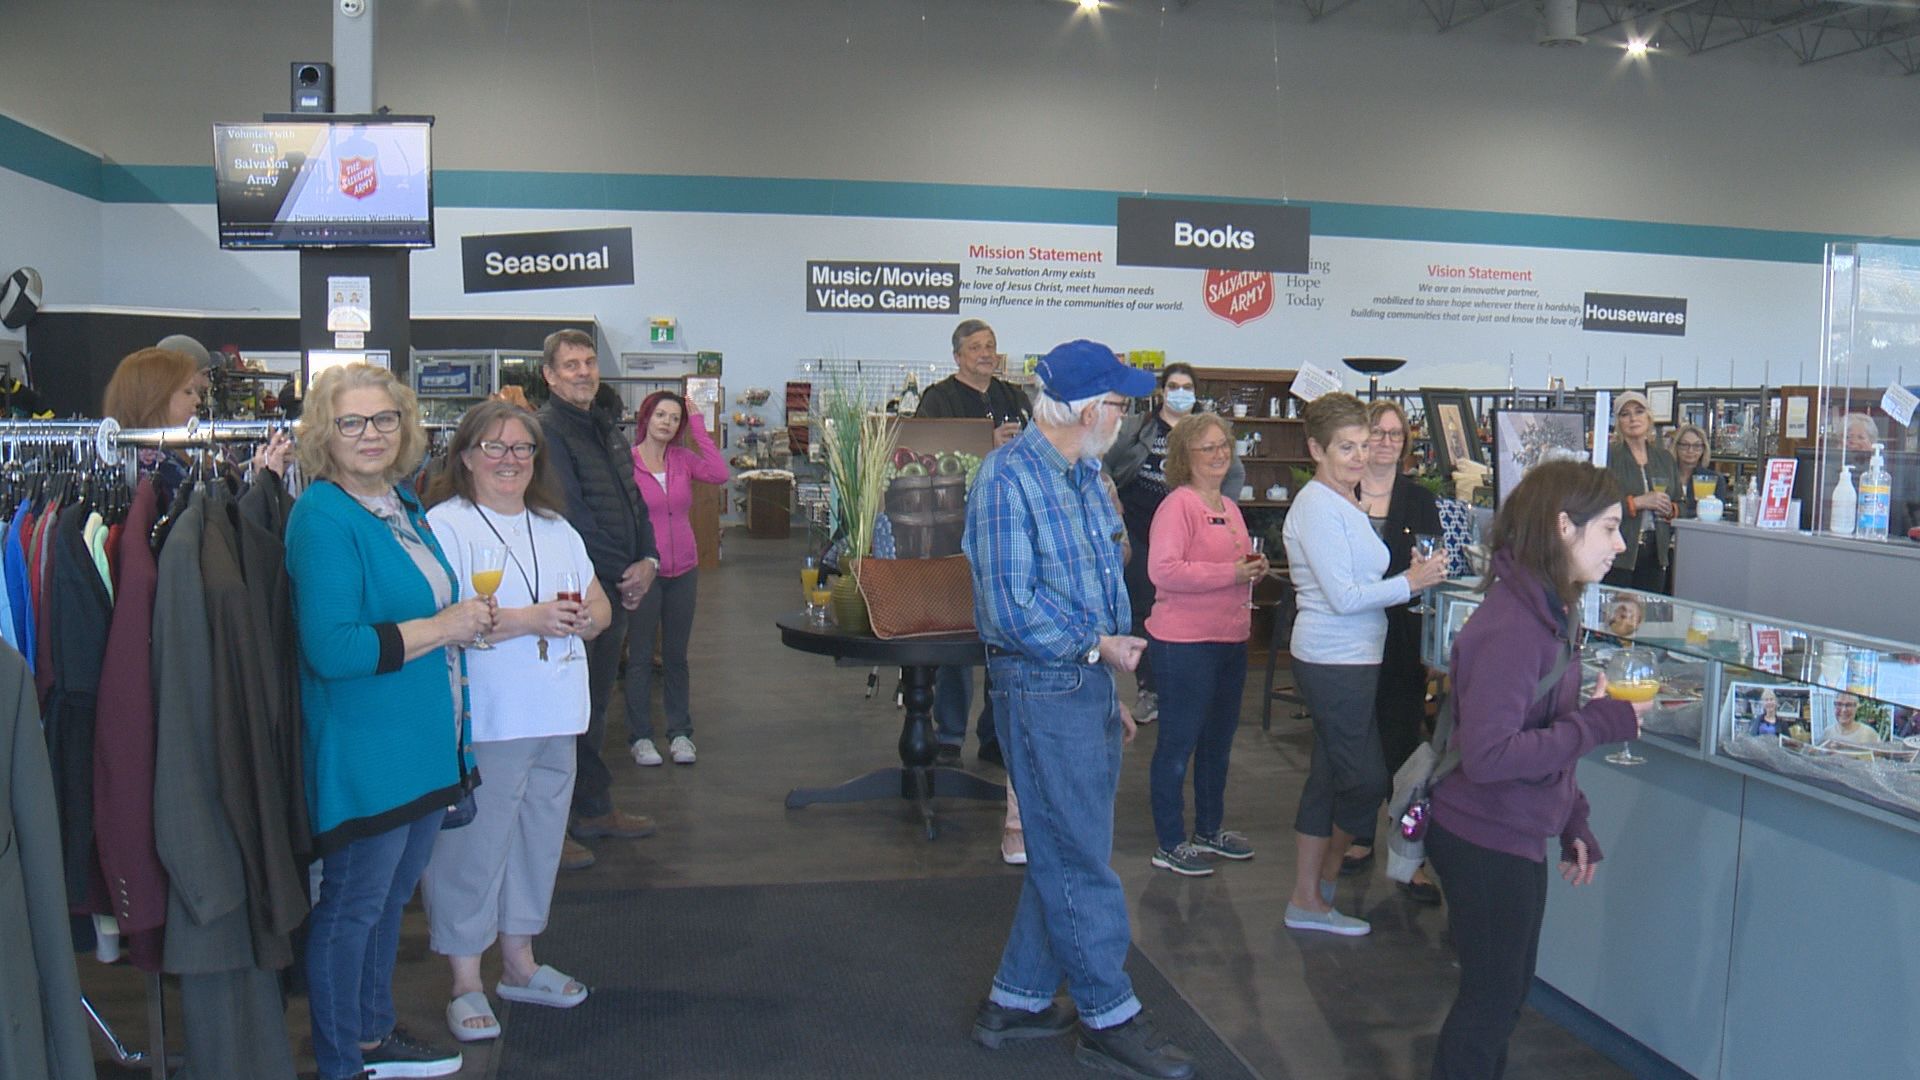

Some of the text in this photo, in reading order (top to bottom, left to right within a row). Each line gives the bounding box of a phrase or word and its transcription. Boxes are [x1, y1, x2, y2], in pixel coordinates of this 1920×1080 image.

[227, 129, 296, 139] Volunteer with
[251, 143, 275, 154] The
[234, 157, 289, 169] Salvation
[246, 174, 279, 187] Army
[353, 177, 375, 196] ARMY
[1174, 221, 1255, 250] Books
[485, 246, 610, 276] Seasonal
[969, 244, 1103, 263] Mission Statement
[812, 265, 954, 287] Music/Movies
[975, 265, 1096, 280] The Salvation Army exists
[1427, 264, 1533, 282] Vision Statement
[959, 280, 1155, 296] he love of Jesus Christ, meet human needs
[1286, 275, 1321, 293] Hope
[1418, 283, 1540, 298] We are an innovative partner,
[816, 288, 950, 310] Video Games
[989, 295, 1033, 307] influence
[1035, 296, 1044, 306] in
[1046, 297, 1062, 307] the
[1063, 298, 1124, 309] communities
[1125, 298, 1137, 310] of
[1137, 300, 1154, 310] our
[1155, 300, 1185, 311] world.
[1229, 281, 1266, 315] ARMY
[1286, 293, 1325, 311] Today
[1373, 295, 1582, 314] mobilized to share hope wherever there is hardship,
[1351, 308, 1385, 320] building
[1386, 309, 1441, 320] communities
[1442, 311, 1460, 321] that
[1461, 313, 1475, 322] are
[1476, 312, 1492, 324] just
[1494, 313, 1510, 323] and
[1511, 313, 1534, 324] know
[1535, 314, 1549, 325] the
[1550, 315, 1567, 325] love
[1568, 315, 1578, 327] of
[1585, 303, 1684, 325] Housewares
